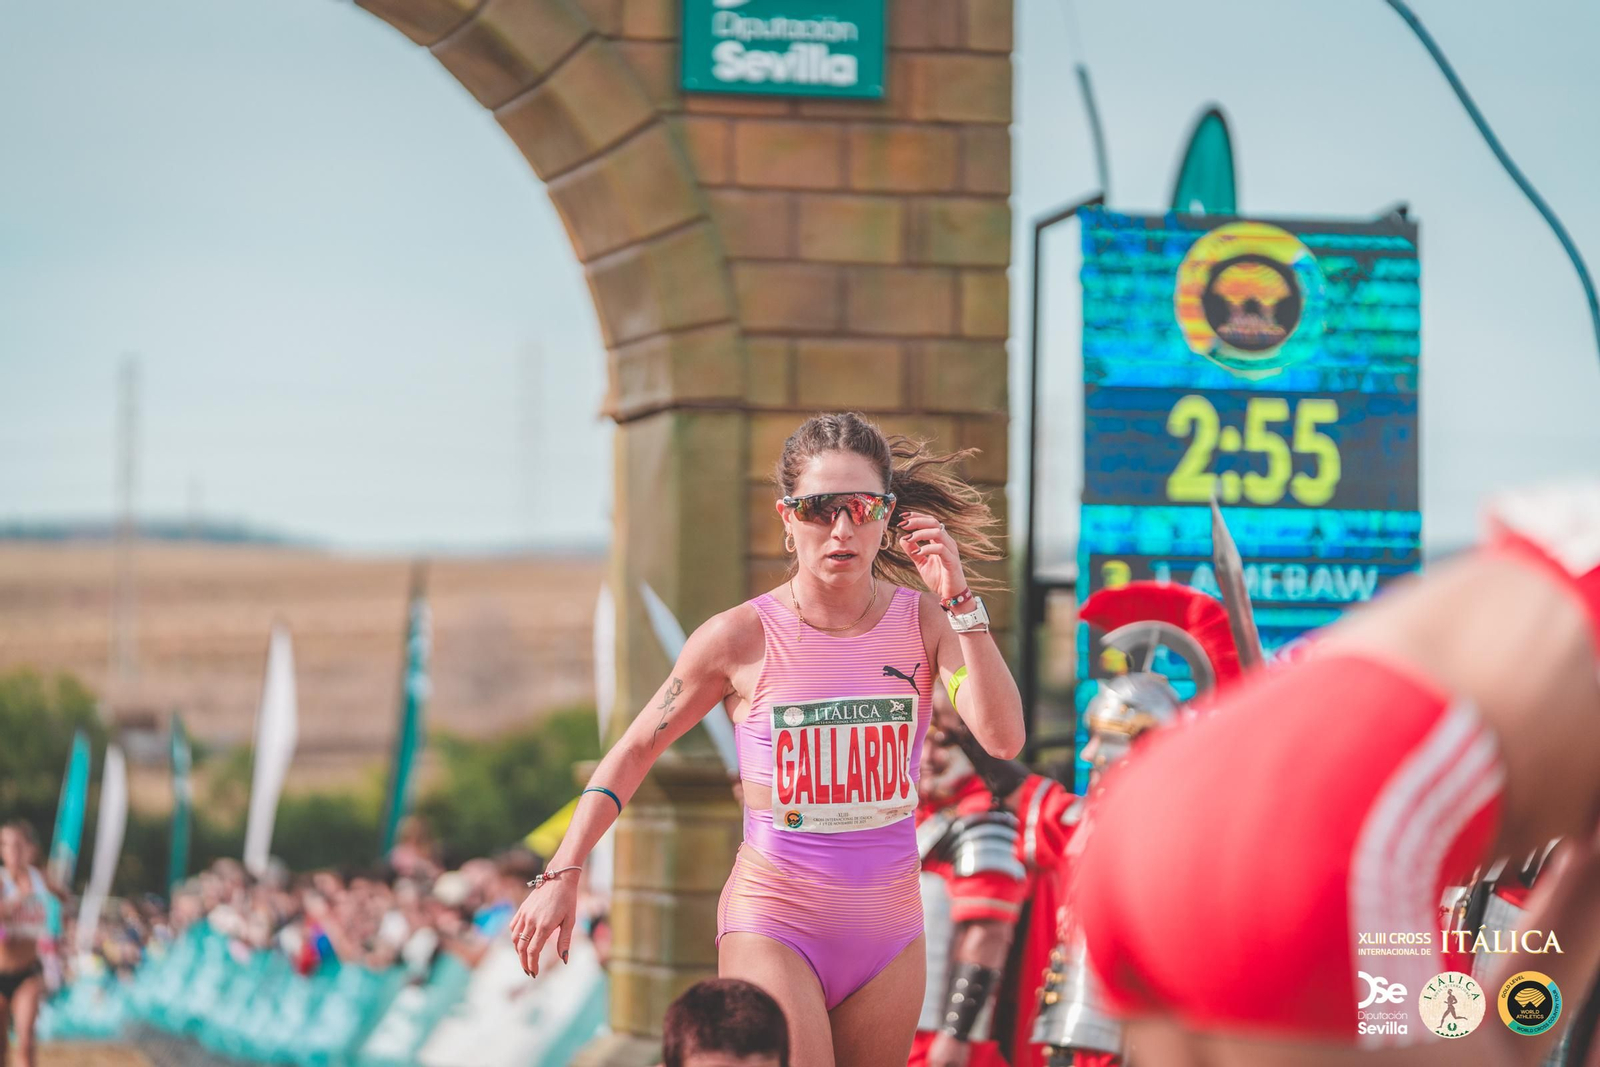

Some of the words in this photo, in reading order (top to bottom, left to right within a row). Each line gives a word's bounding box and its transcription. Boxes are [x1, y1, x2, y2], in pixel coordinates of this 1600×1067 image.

[711, 40, 858, 87] Sevilla
[1166, 394, 1342, 507] 2:55
[814, 702, 881, 721] ITÁLICA
[776, 723, 910, 805] GALLARDO
